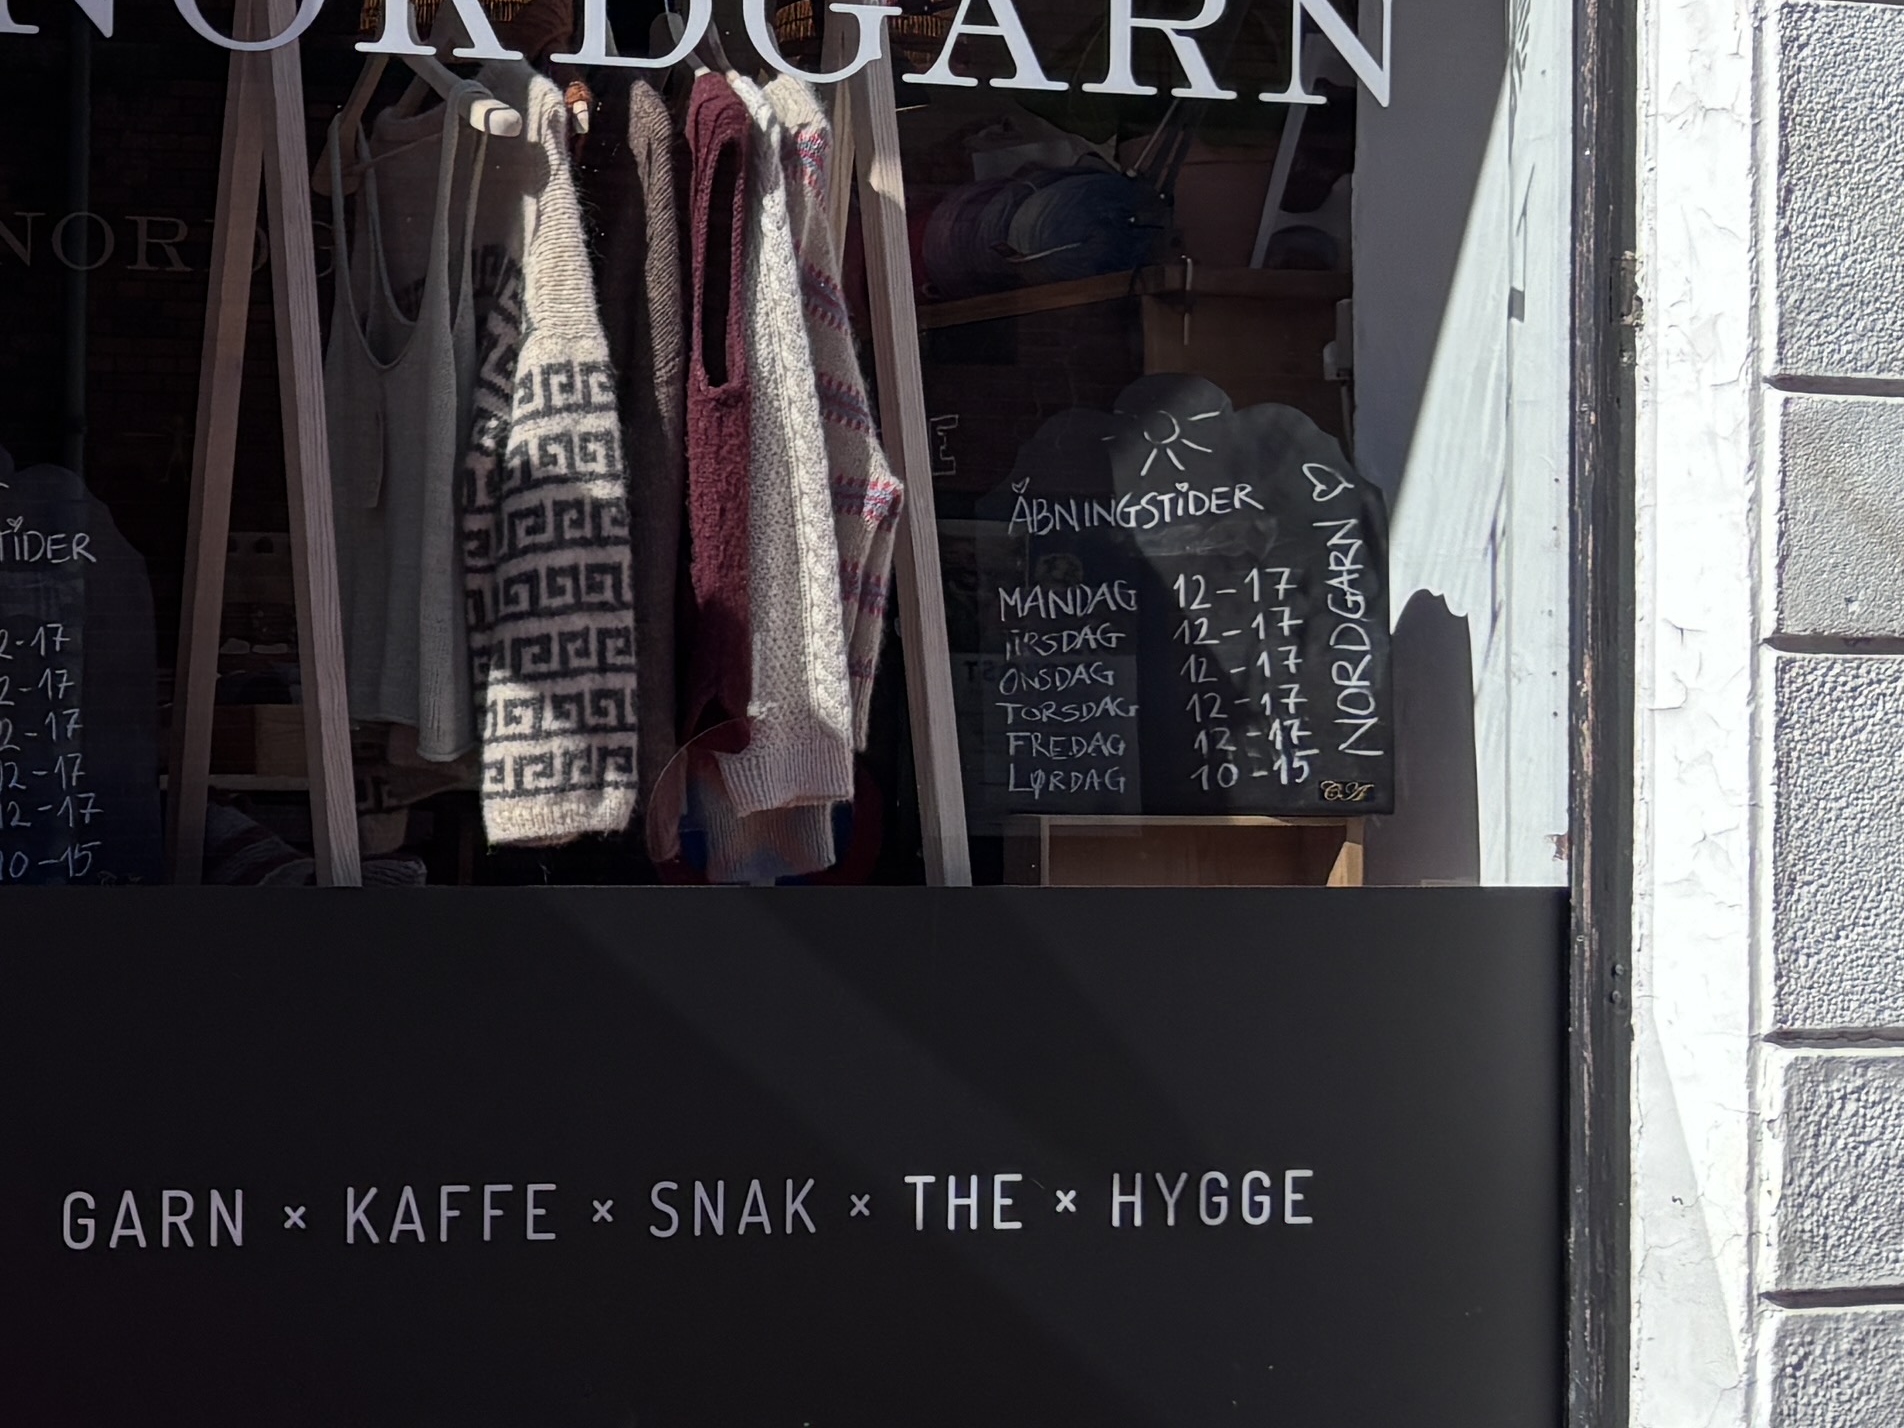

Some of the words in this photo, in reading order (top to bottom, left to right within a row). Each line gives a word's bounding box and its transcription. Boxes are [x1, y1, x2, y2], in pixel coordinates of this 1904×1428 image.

[1007, 476, 1265, 536] ÅBNINGSTIDER
[998, 579, 1138, 622] MANDAG
[1311, 516, 1385, 757] NORDGARN
[998, 661, 1115, 696] ONSDAG
[995, 695, 1140, 725] TORSDAG
[1007, 763, 1127, 800] LØRDAG
[61, 1186, 246, 1250] GARN
[345, 1182, 558, 1246] KAFFE
[647, 1176, 821, 1239] SNAK
[903, 1173, 1025, 1232] THE
[1110, 1167, 1316, 1228] HYGGE
